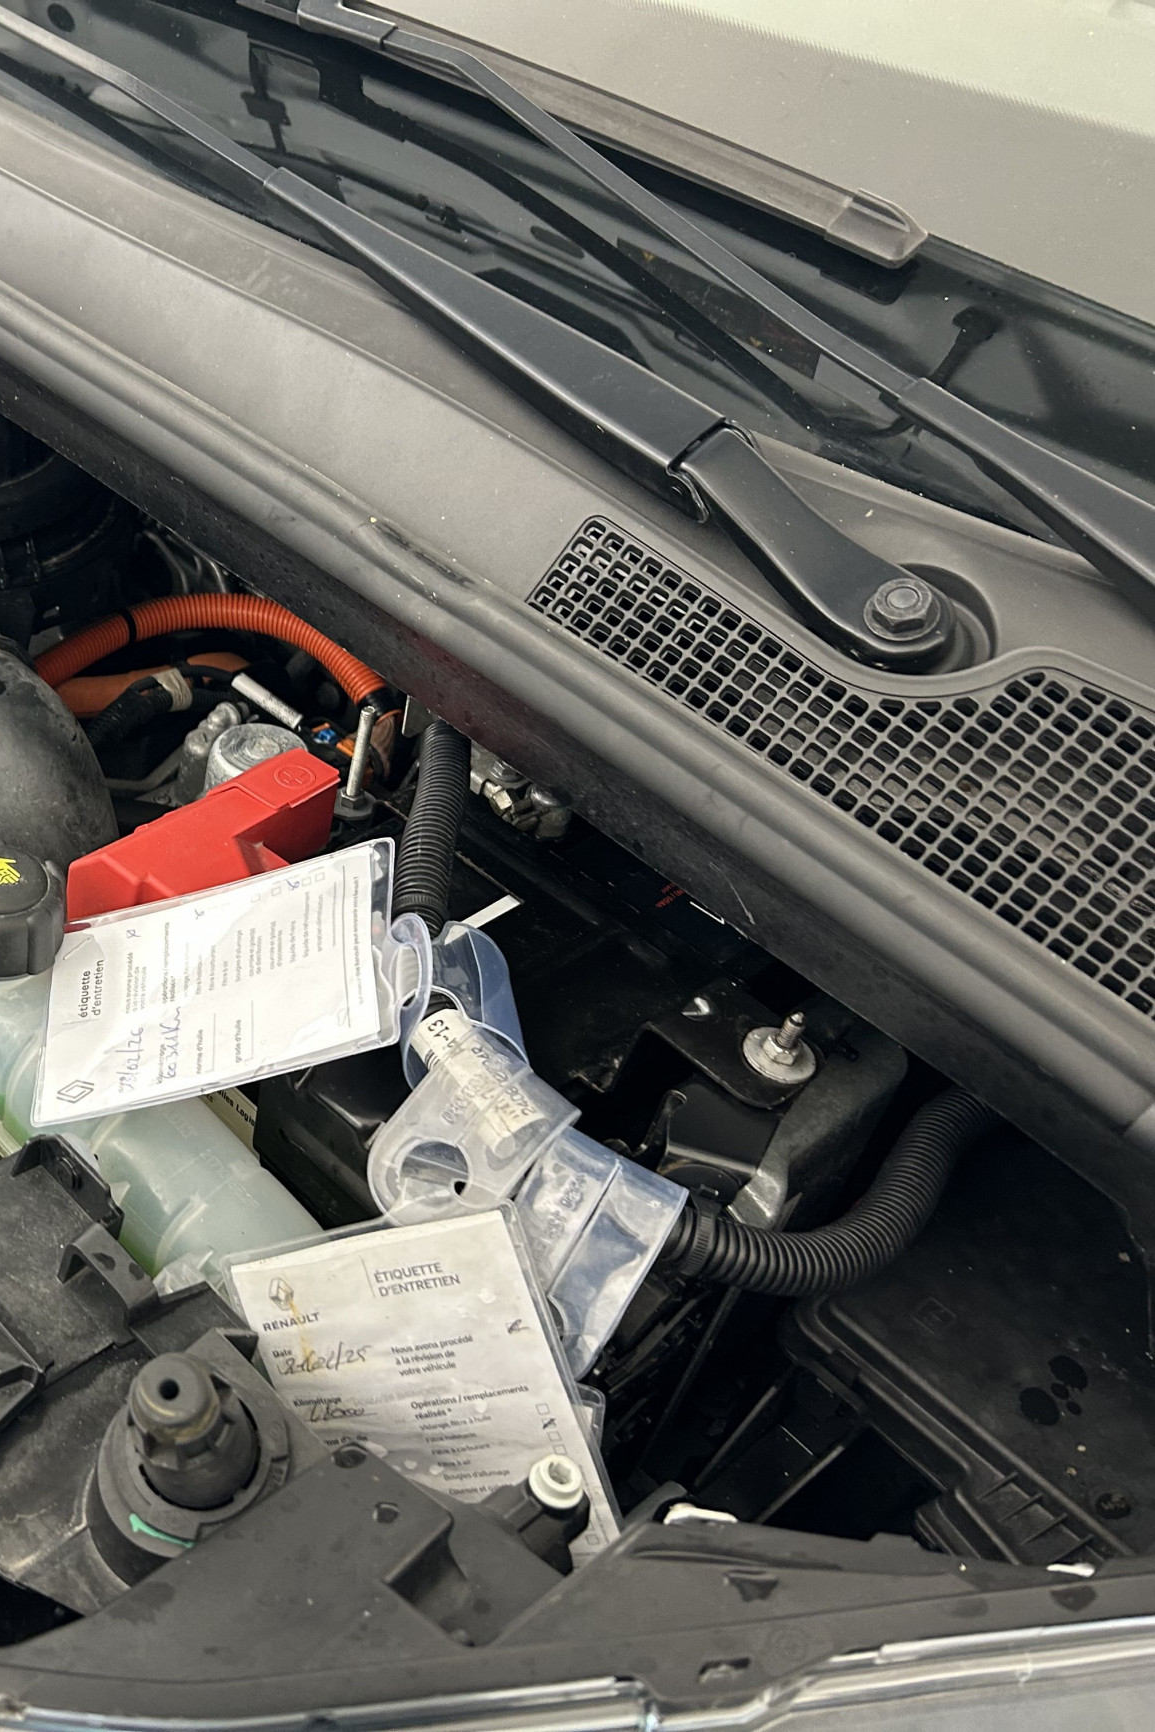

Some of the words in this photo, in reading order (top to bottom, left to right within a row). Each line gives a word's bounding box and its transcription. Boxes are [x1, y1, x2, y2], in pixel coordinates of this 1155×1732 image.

[78, 970, 90, 1017] étiquette
[91, 959, 103, 1015] d'entretien
[374, 1262, 443, 1283] ÉTIQUETTE
[379, 1274, 461, 1297] D'ENTRETIEN
[262, 1312, 320, 1332] RENAULT
[390, 1346, 413, 1354] Nous
[415, 1343, 438, 1351] avons
[439, 1334, 473, 1349] procédé
[272, 1350, 292, 1359] Date
[411, 1352, 443, 1363] révision
[445, 1350, 455, 1358] de
[399, 1368, 421, 1377] votre
[422, 1361, 456, 1373] véhicule
[410, 1397, 457, 1410] Opérations
[463, 1385, 529, 1401] remplacements
[415, 1408, 447, 1420] réalisés
